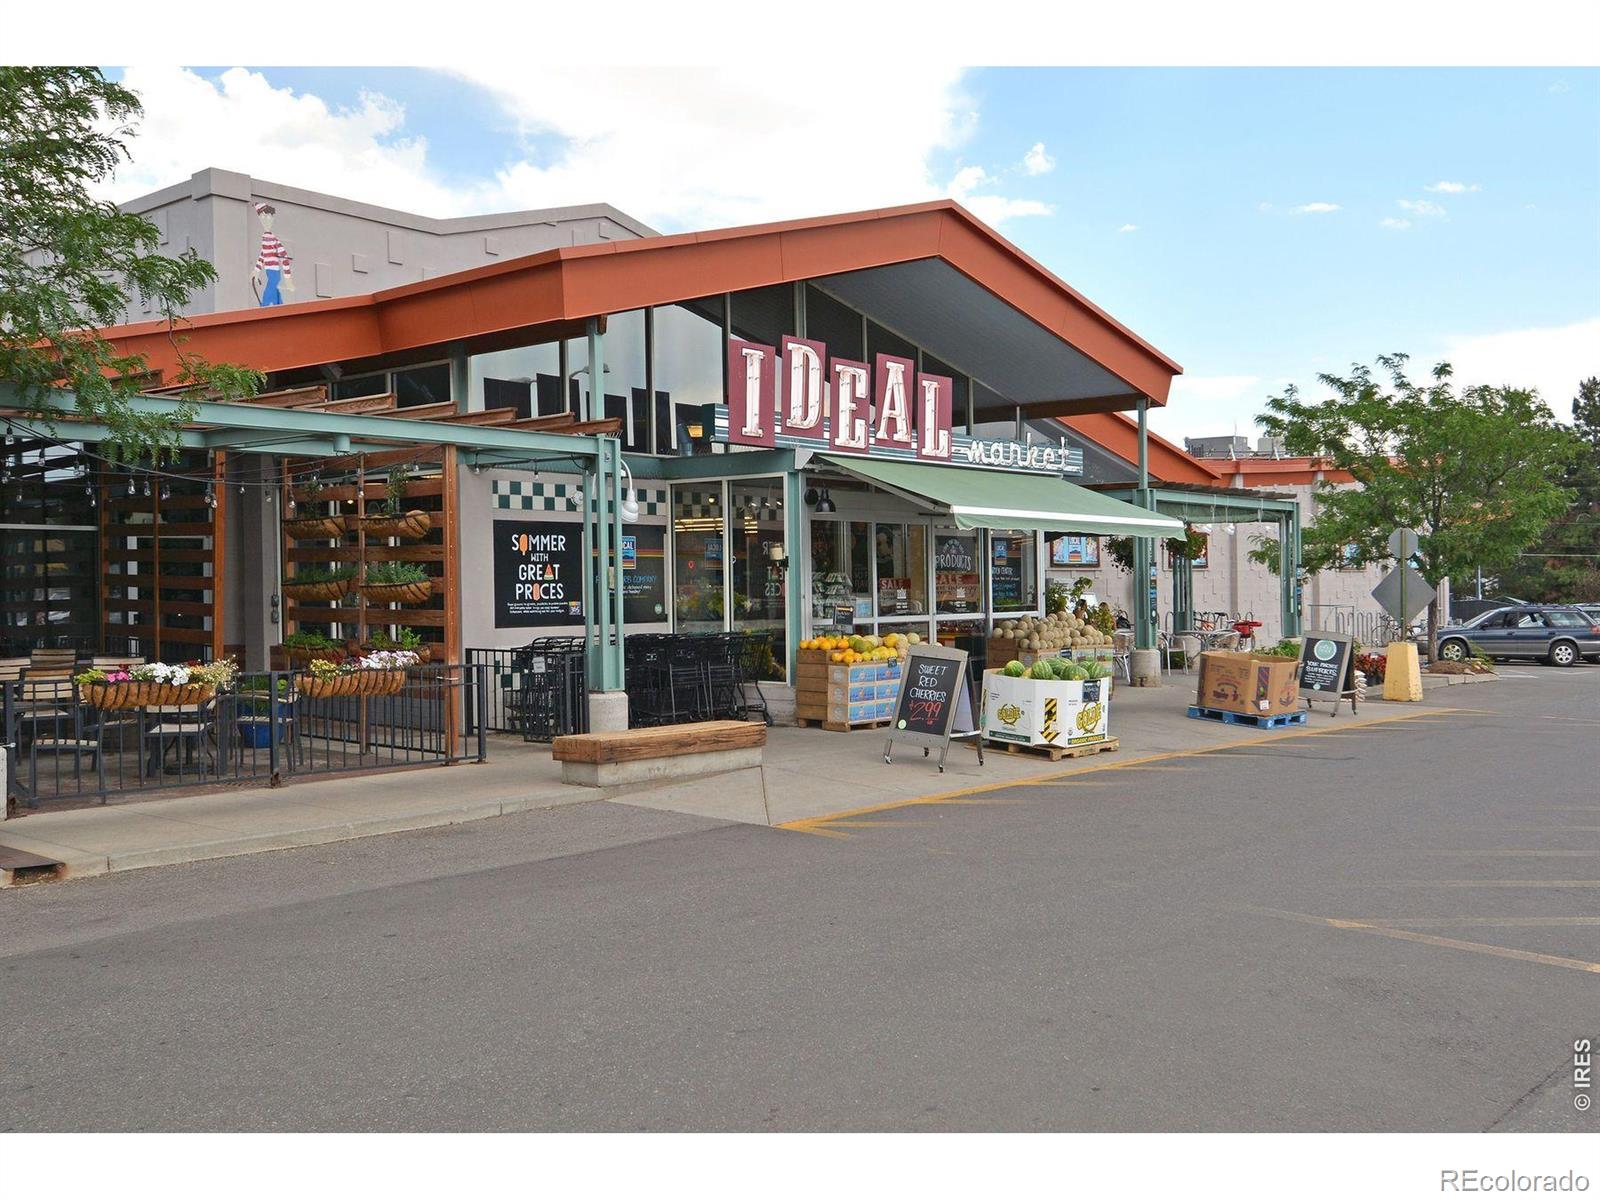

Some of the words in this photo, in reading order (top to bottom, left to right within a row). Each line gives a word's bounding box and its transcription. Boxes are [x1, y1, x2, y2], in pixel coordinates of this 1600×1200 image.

[741, 341, 950, 458] IDEAL
[966, 432, 1082, 473] market
[622, 541, 634, 550] CAL
[530, 553, 549, 562] WITH
[935, 555, 972, 571] PRODUCTS
[518, 564, 560, 581] GREAT
[515, 582, 564, 601] PRICES
[918, 663, 948, 676] SWEET
[918, 676, 938, 687] RED
[909, 687, 947, 702] CHERRIES
